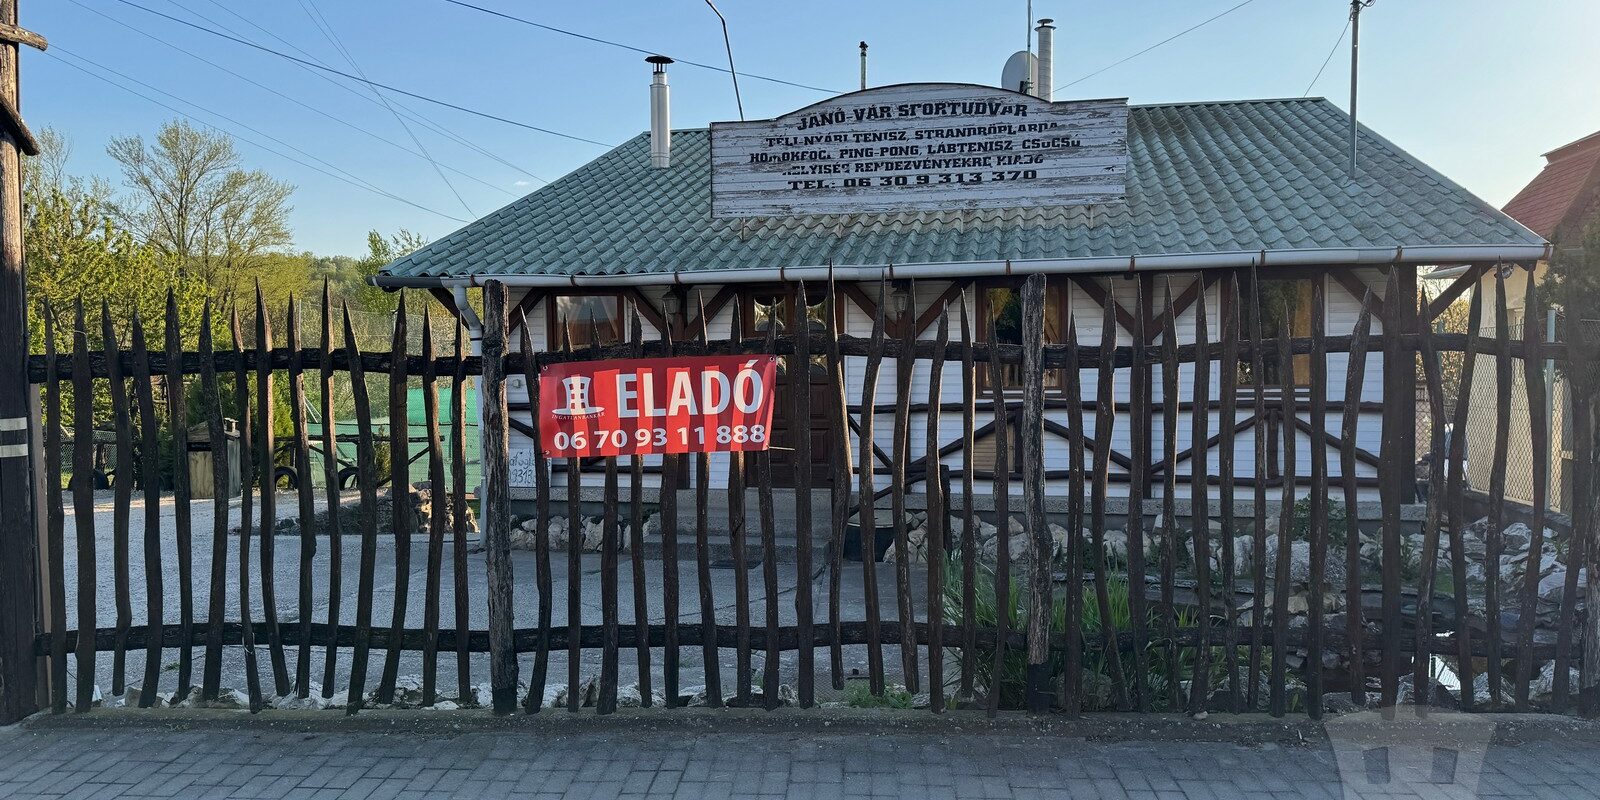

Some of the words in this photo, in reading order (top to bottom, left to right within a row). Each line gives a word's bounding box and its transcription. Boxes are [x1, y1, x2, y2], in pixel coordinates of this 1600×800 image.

[853, 131, 909, 143] TENISZ,
[839, 145, 922, 159] PING-PONG,
[927, 141, 1013, 154] LÁBTENISZ
[787, 180, 836, 190] TEL:
[843, 178, 871, 187] 06
[879, 176, 907, 186] 30
[916, 174, 930, 185] 9
[938, 173, 982, 184] 313
[991, 170, 1037, 181] 370
[615, 359, 763, 418] ELADÓ
[553, 430, 587, 450] 06
[593, 429, 628, 449] 70
[634, 427, 668, 447] 93
[677, 426, 705, 445] 11
[715, 424, 766, 444] 888
